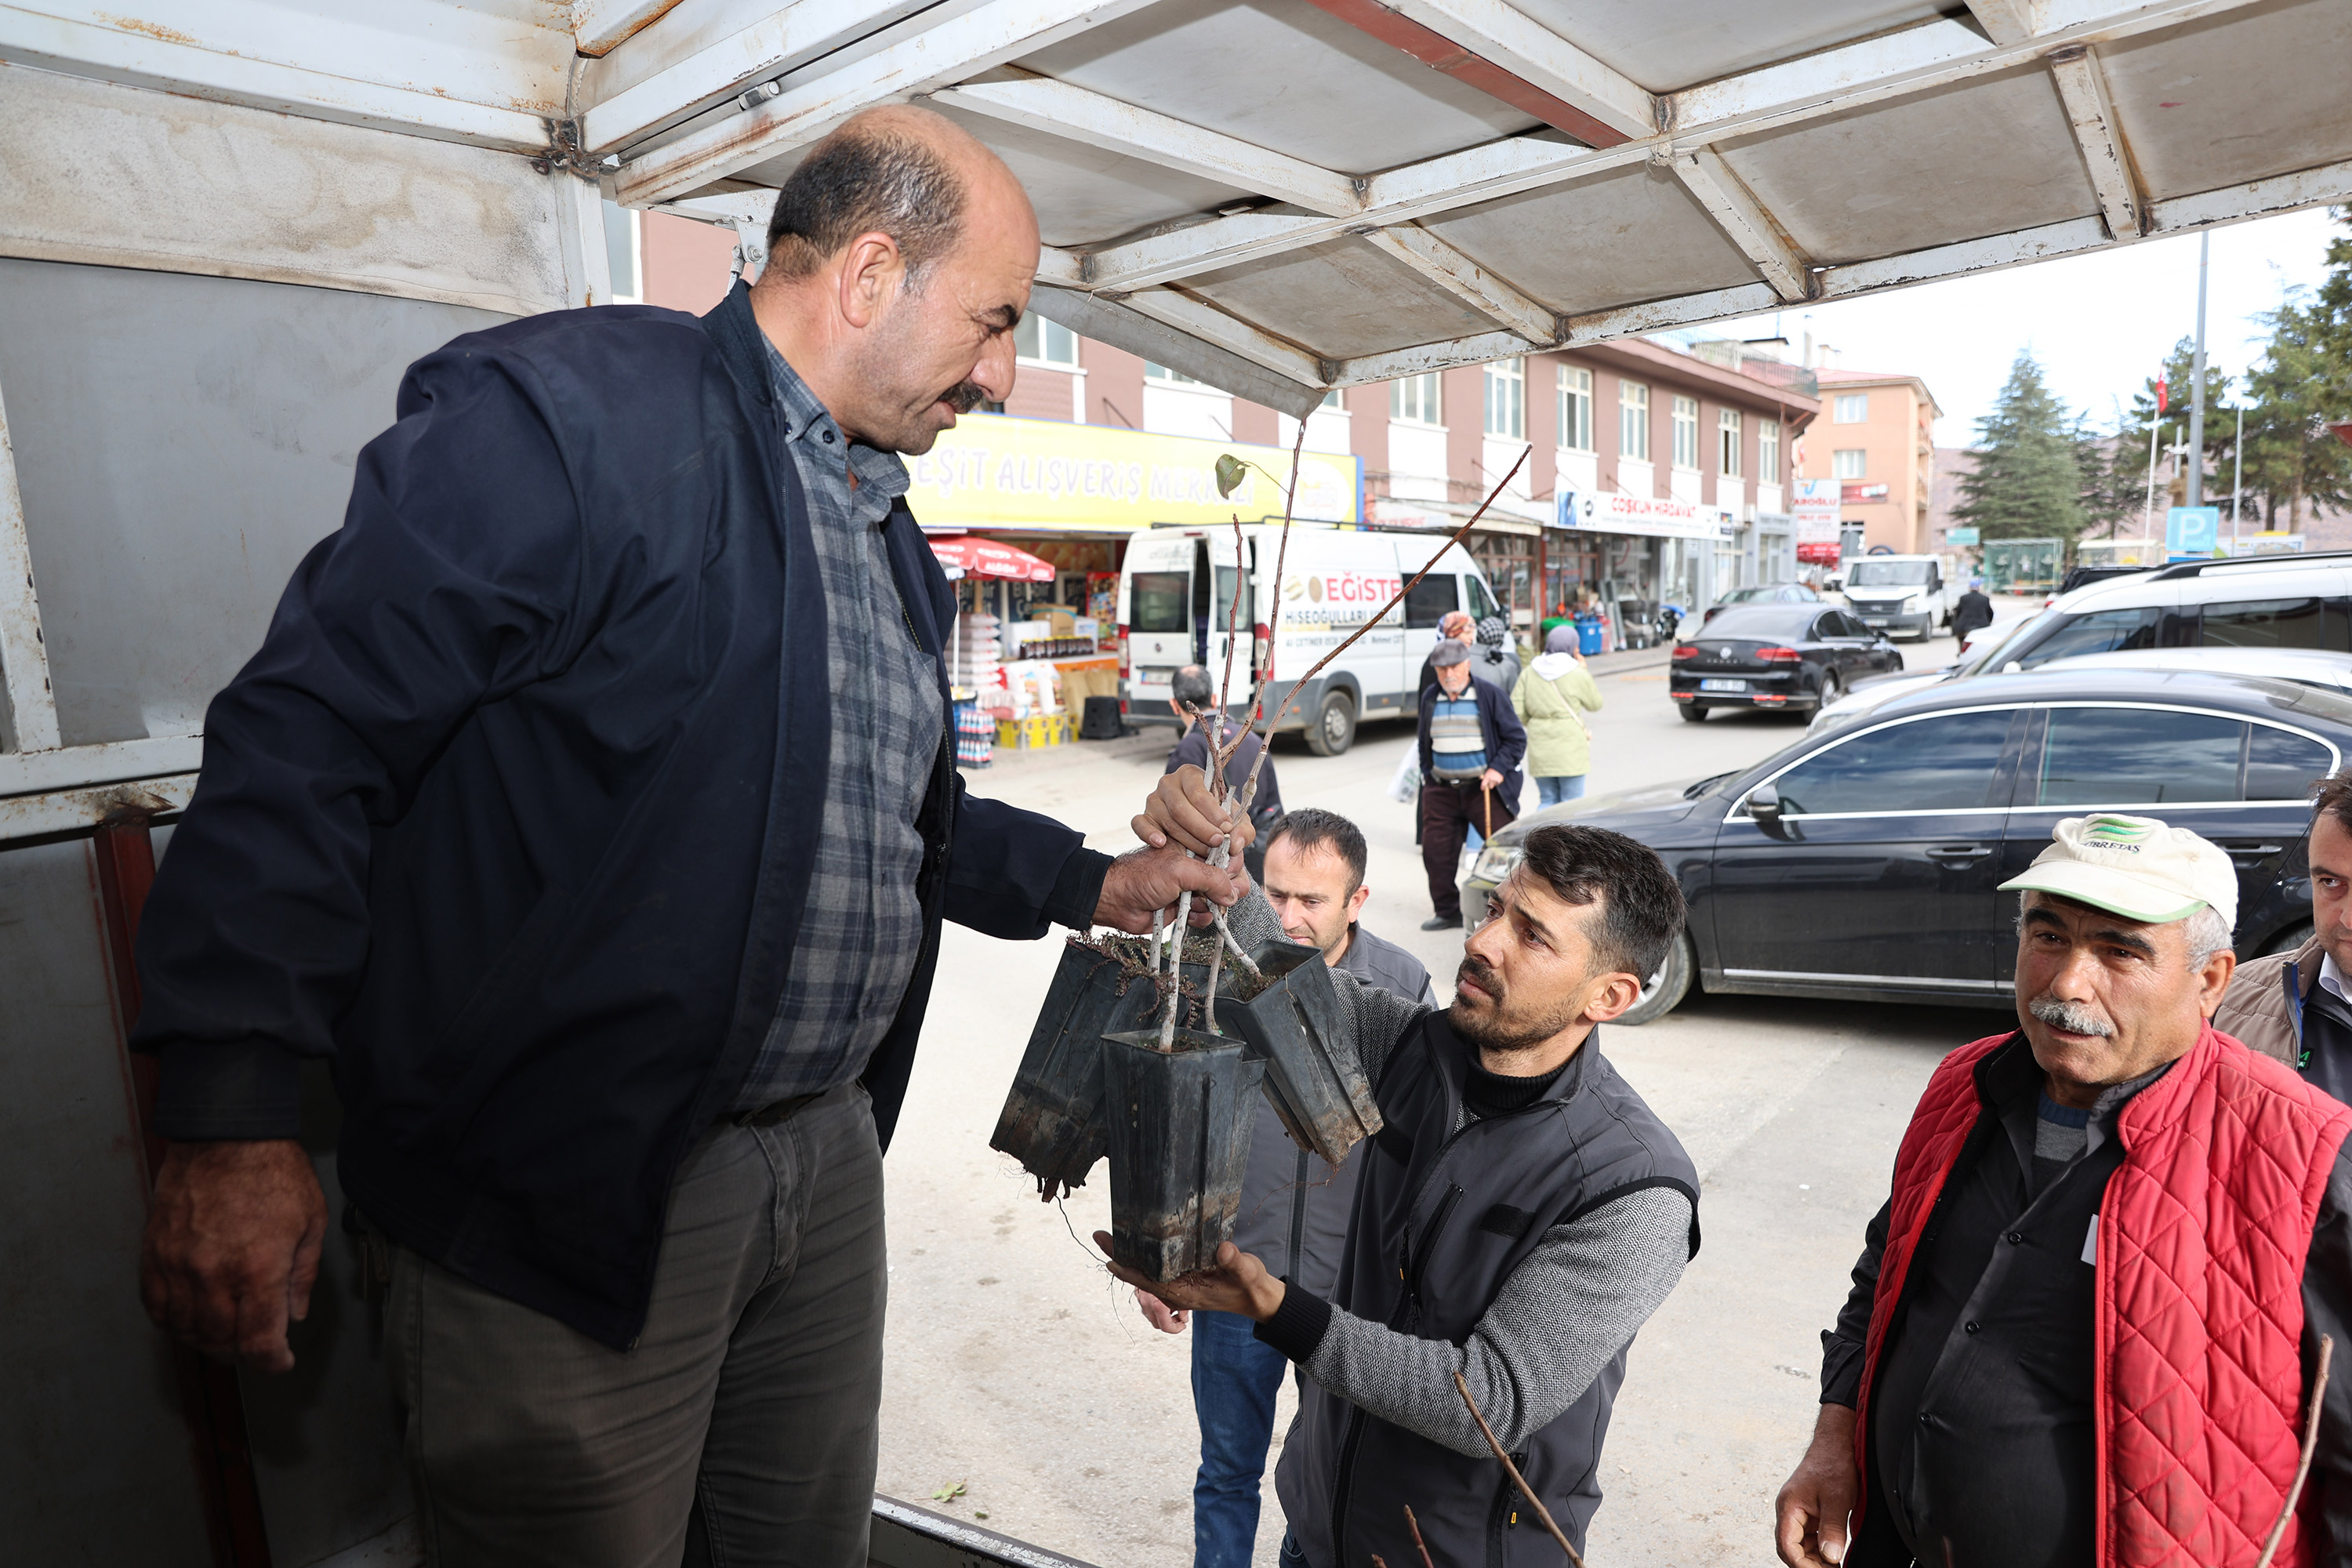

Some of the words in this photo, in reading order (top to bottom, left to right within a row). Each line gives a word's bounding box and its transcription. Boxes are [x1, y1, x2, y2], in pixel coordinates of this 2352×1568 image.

[1611, 496, 1652, 515] COŞKUN
[1654, 501, 1697, 519] HIRDAVAT
[2178, 512, 2207, 547] P
